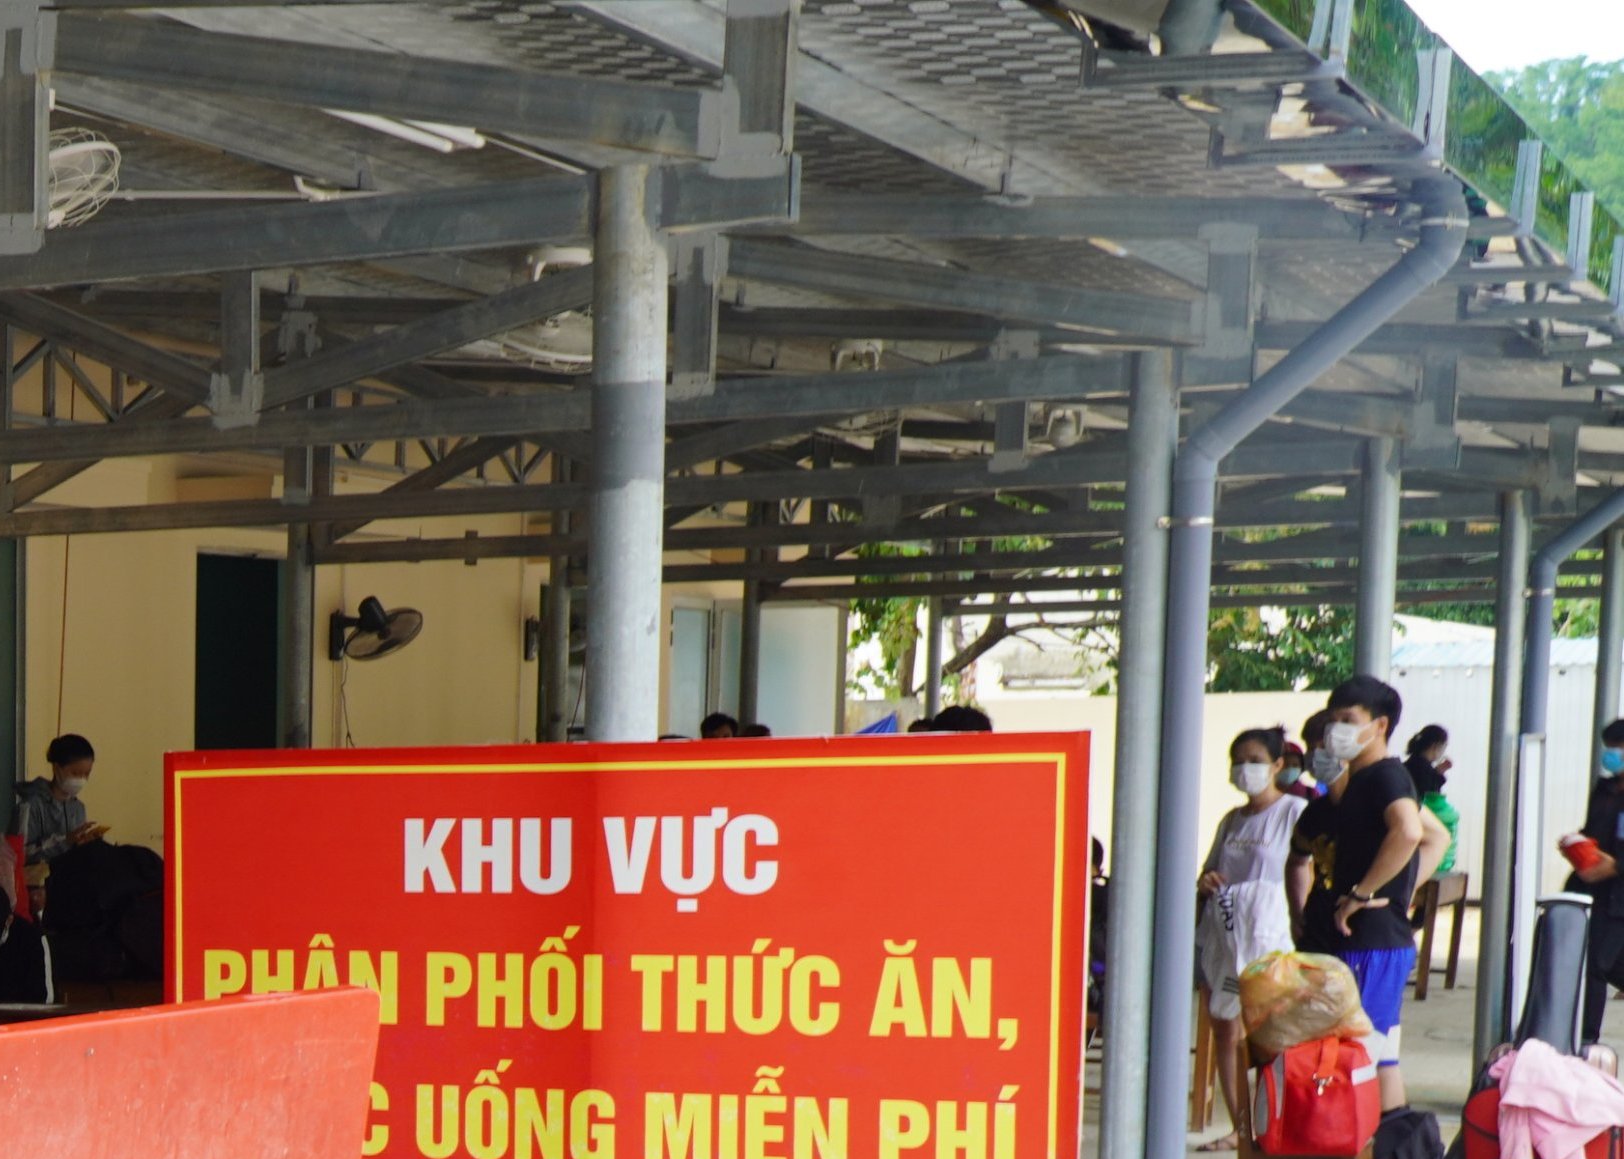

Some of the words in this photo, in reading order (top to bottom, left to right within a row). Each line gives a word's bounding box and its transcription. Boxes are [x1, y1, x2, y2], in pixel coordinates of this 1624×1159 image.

[404, 817, 572, 894] KHU
[602, 806, 779, 912] VỰC
[425, 925, 603, 1030] PHỐI
[630, 937, 841, 1037] THỨC
[868, 938, 1019, 1051] ĂN,
